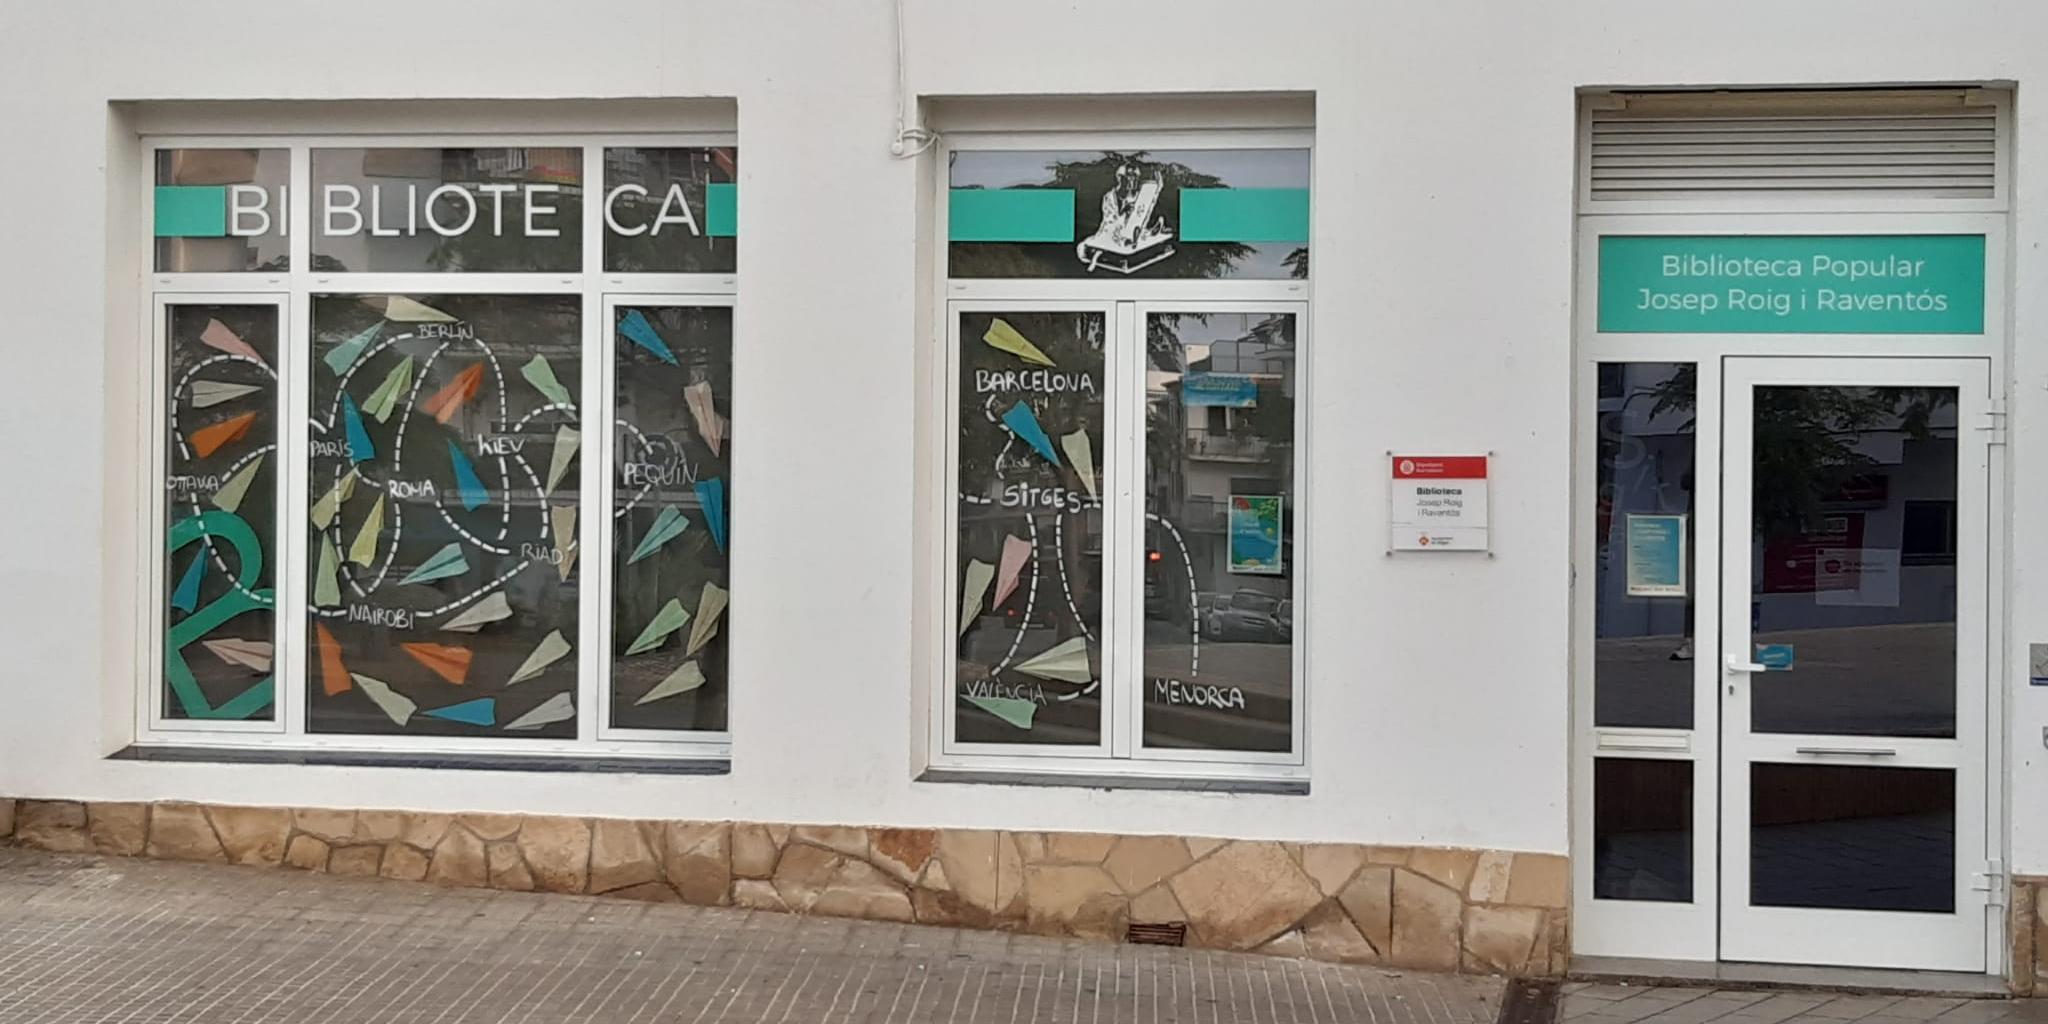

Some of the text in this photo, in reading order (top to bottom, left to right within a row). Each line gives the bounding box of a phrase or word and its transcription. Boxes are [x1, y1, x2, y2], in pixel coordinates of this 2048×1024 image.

[1661, 254, 1925, 283] Biblioteca Popular
[1637, 287, 1949, 316] Josep Roig i Raventós
[975, 368, 1096, 394] BARCELONA
[477, 432, 527, 456] KIEV
[387, 478, 436, 499] ROMA
[1416, 487, 1462, 496] Biblioteca
[1154, 677, 1246, 710] MENORCA
